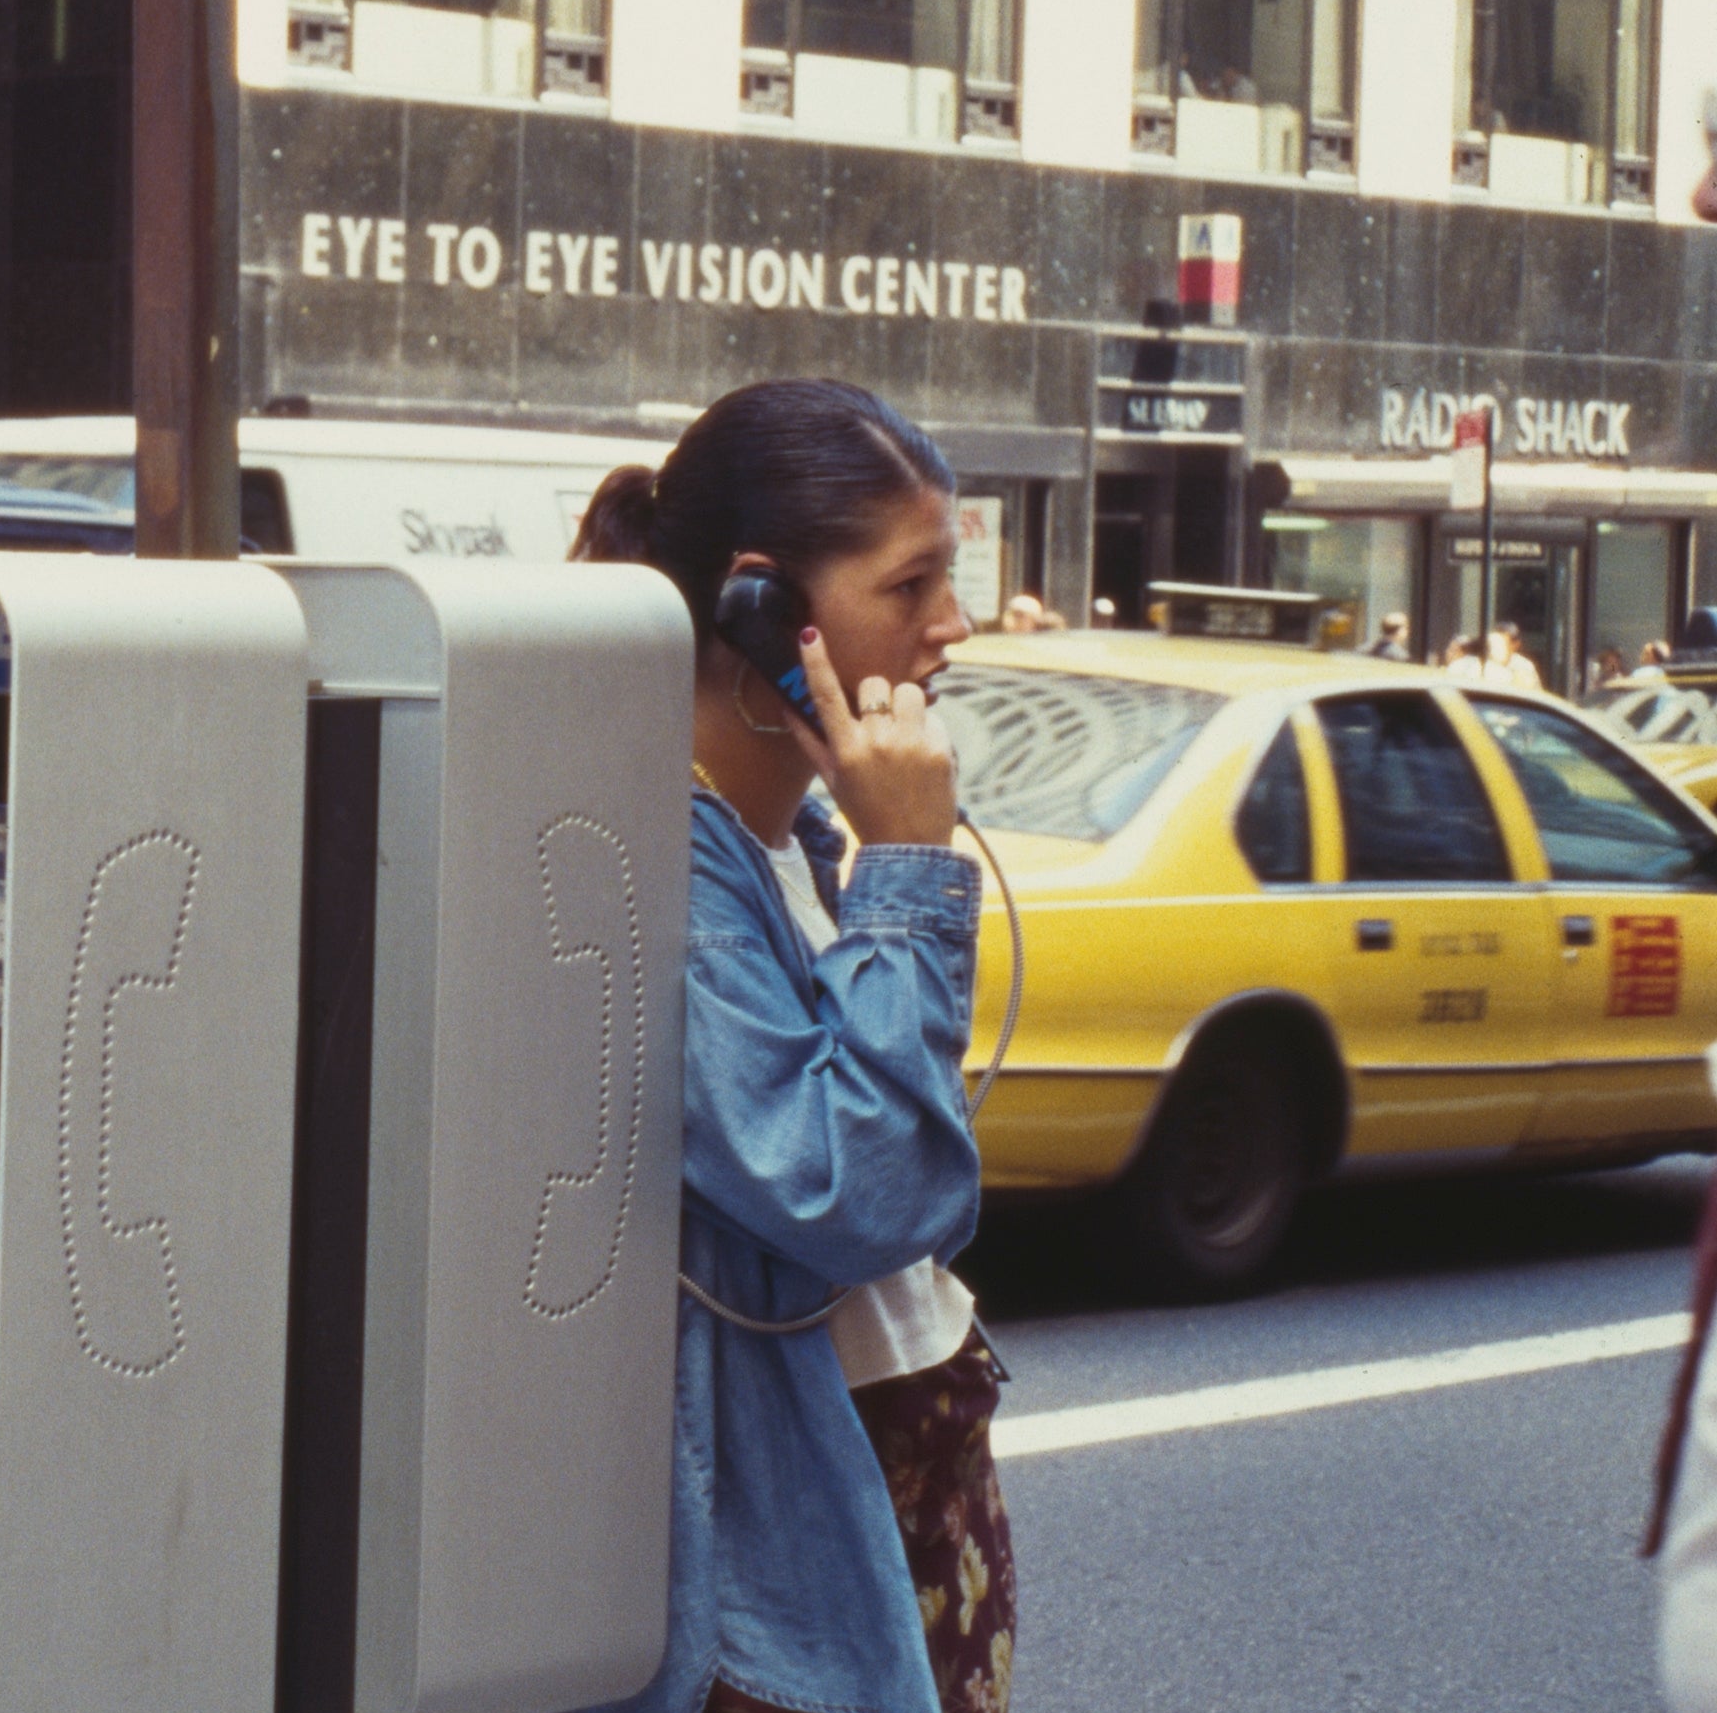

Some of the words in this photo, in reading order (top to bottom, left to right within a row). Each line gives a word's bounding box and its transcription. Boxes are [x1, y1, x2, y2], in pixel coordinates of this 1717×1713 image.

[301, 212, 407, 283] EYE
[425, 222, 503, 289] TO
[525, 230, 619, 297] EYE
[640, 239, 825, 311] VISION
[840, 254, 1027, 323] CENTER
[1515, 396, 1631, 457] SHACK
